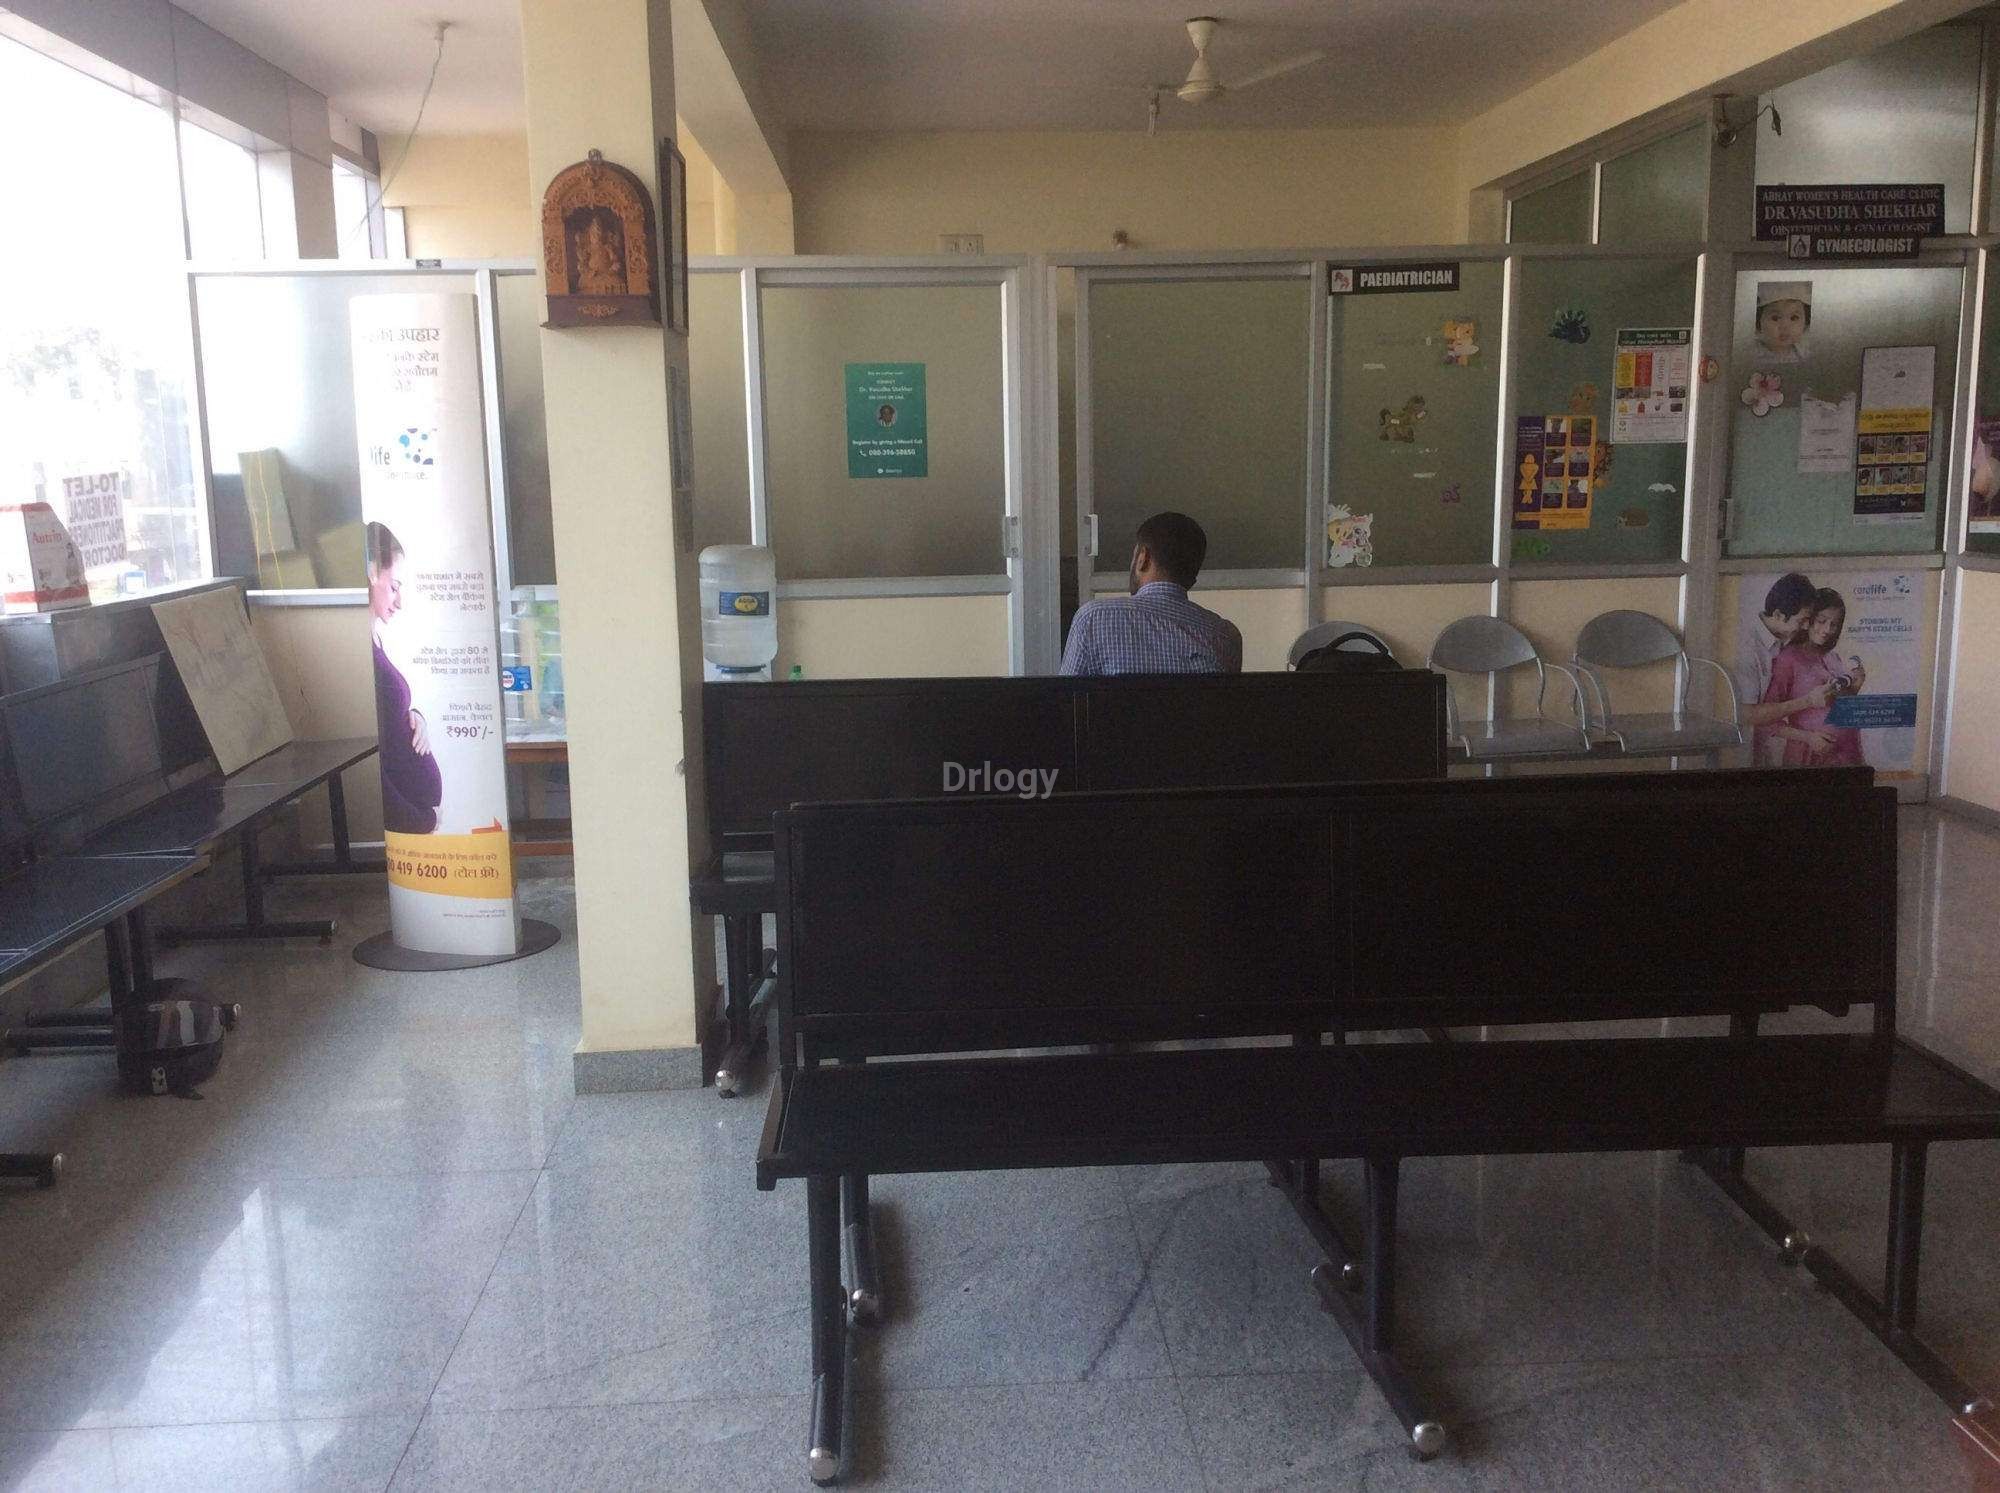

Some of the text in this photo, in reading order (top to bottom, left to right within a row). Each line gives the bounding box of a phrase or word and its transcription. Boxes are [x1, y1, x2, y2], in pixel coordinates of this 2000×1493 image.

[1841, 189, 1878, 200] HEALTH
[1881, 188, 1906, 200] CARE
[1908, 188, 1940, 199] CLINIC
[1864, 203, 1937, 218] SHEKHAR
[1816, 238, 1914, 253] GYNAECOLOGIST
[1360, 270, 1453, 287] PAEDIATRICIAN
[468, 646, 480, 655] 80
[397, 860, 412, 876] 419
[417, 862, 448, 880] 6200
